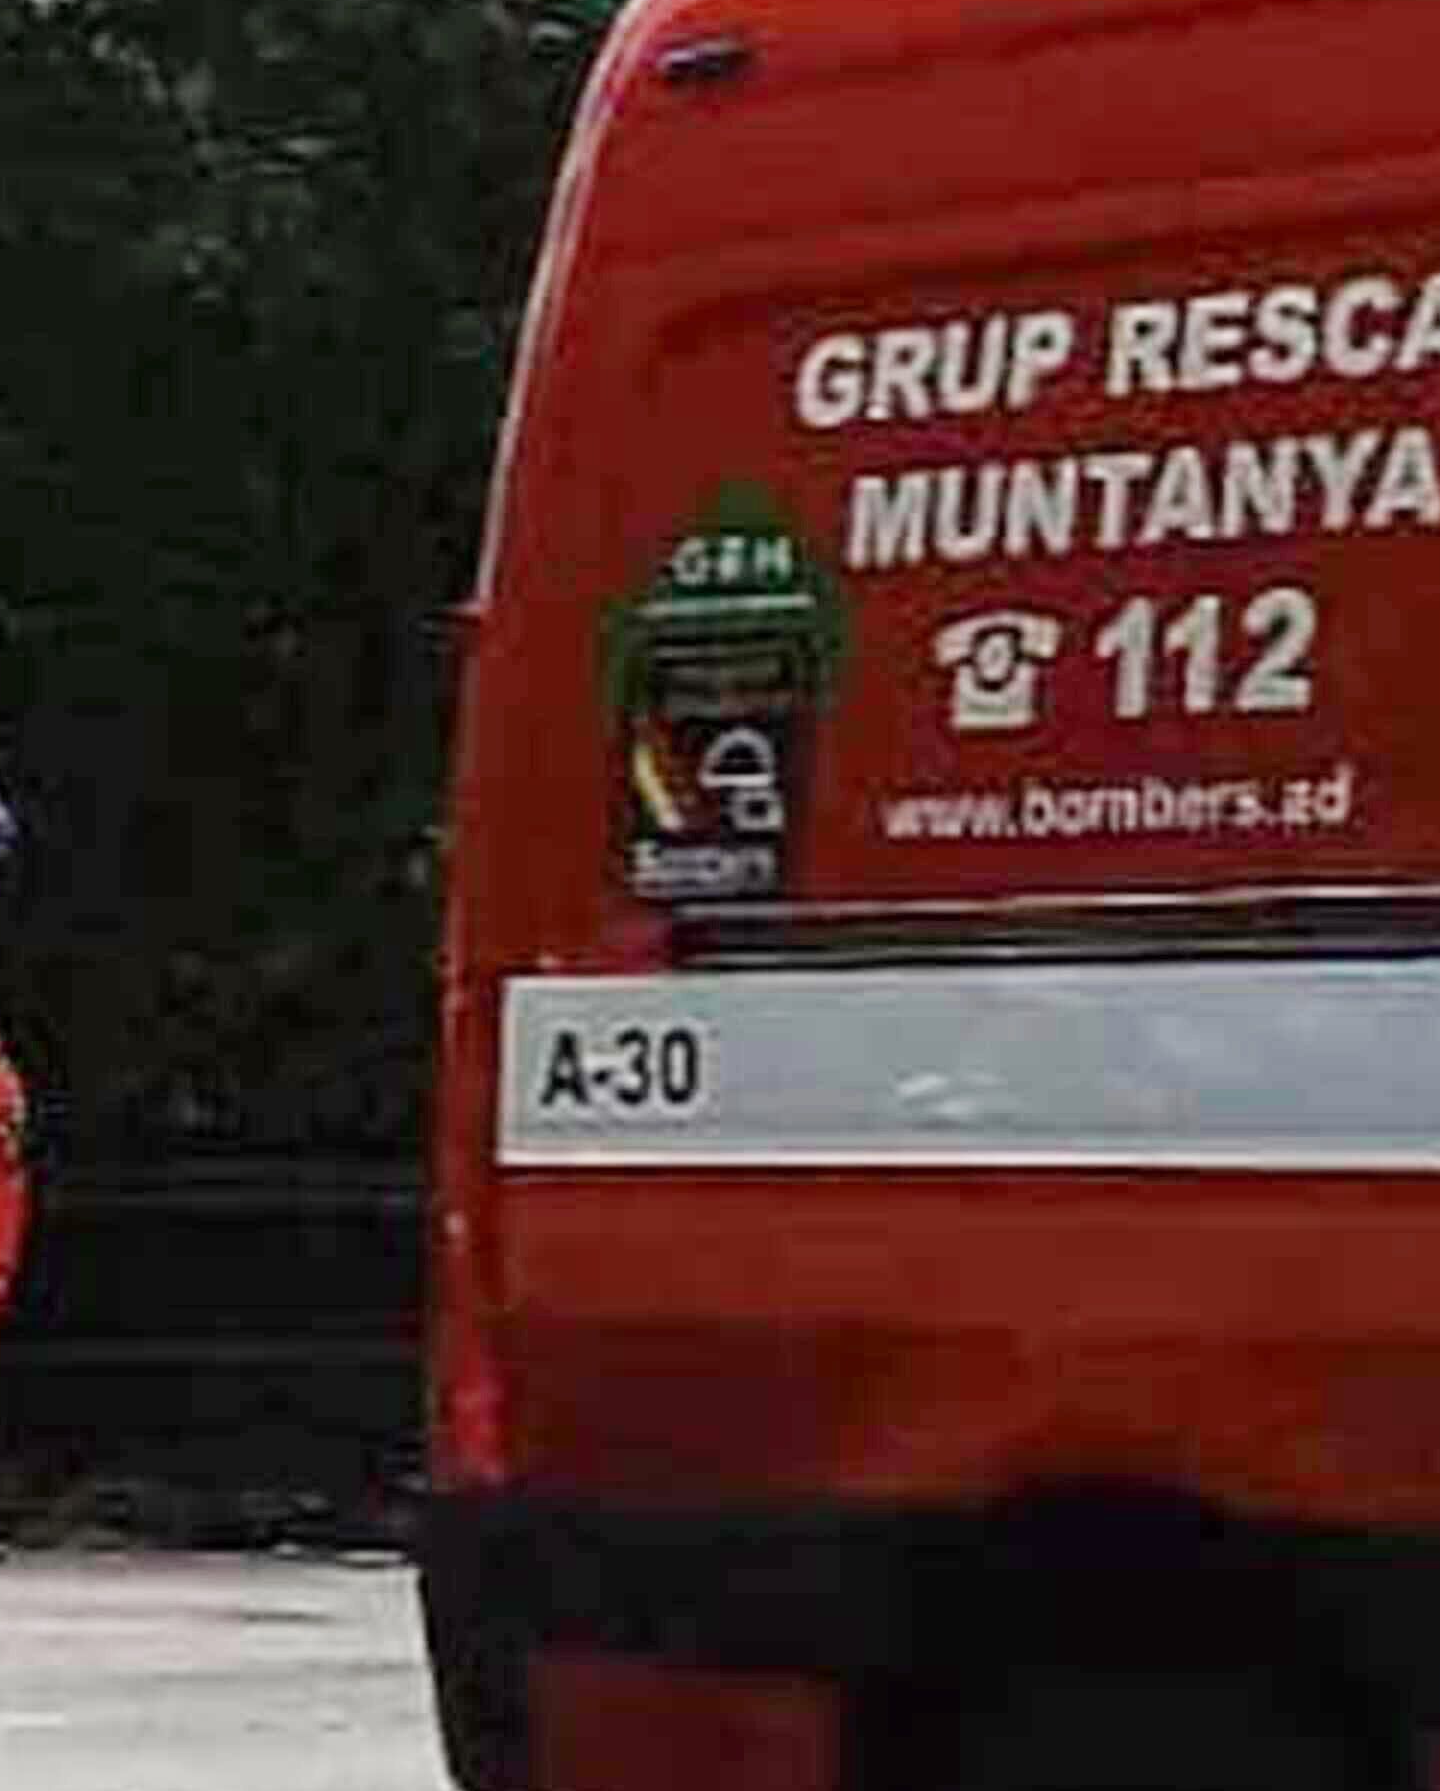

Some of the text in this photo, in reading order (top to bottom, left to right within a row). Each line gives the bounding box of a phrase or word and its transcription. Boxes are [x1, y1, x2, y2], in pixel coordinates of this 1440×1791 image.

[796, 312, 1073, 428] GRUP
[1097, 587, 1317, 720] 112
[540, 1027, 700, 1106] A-30
